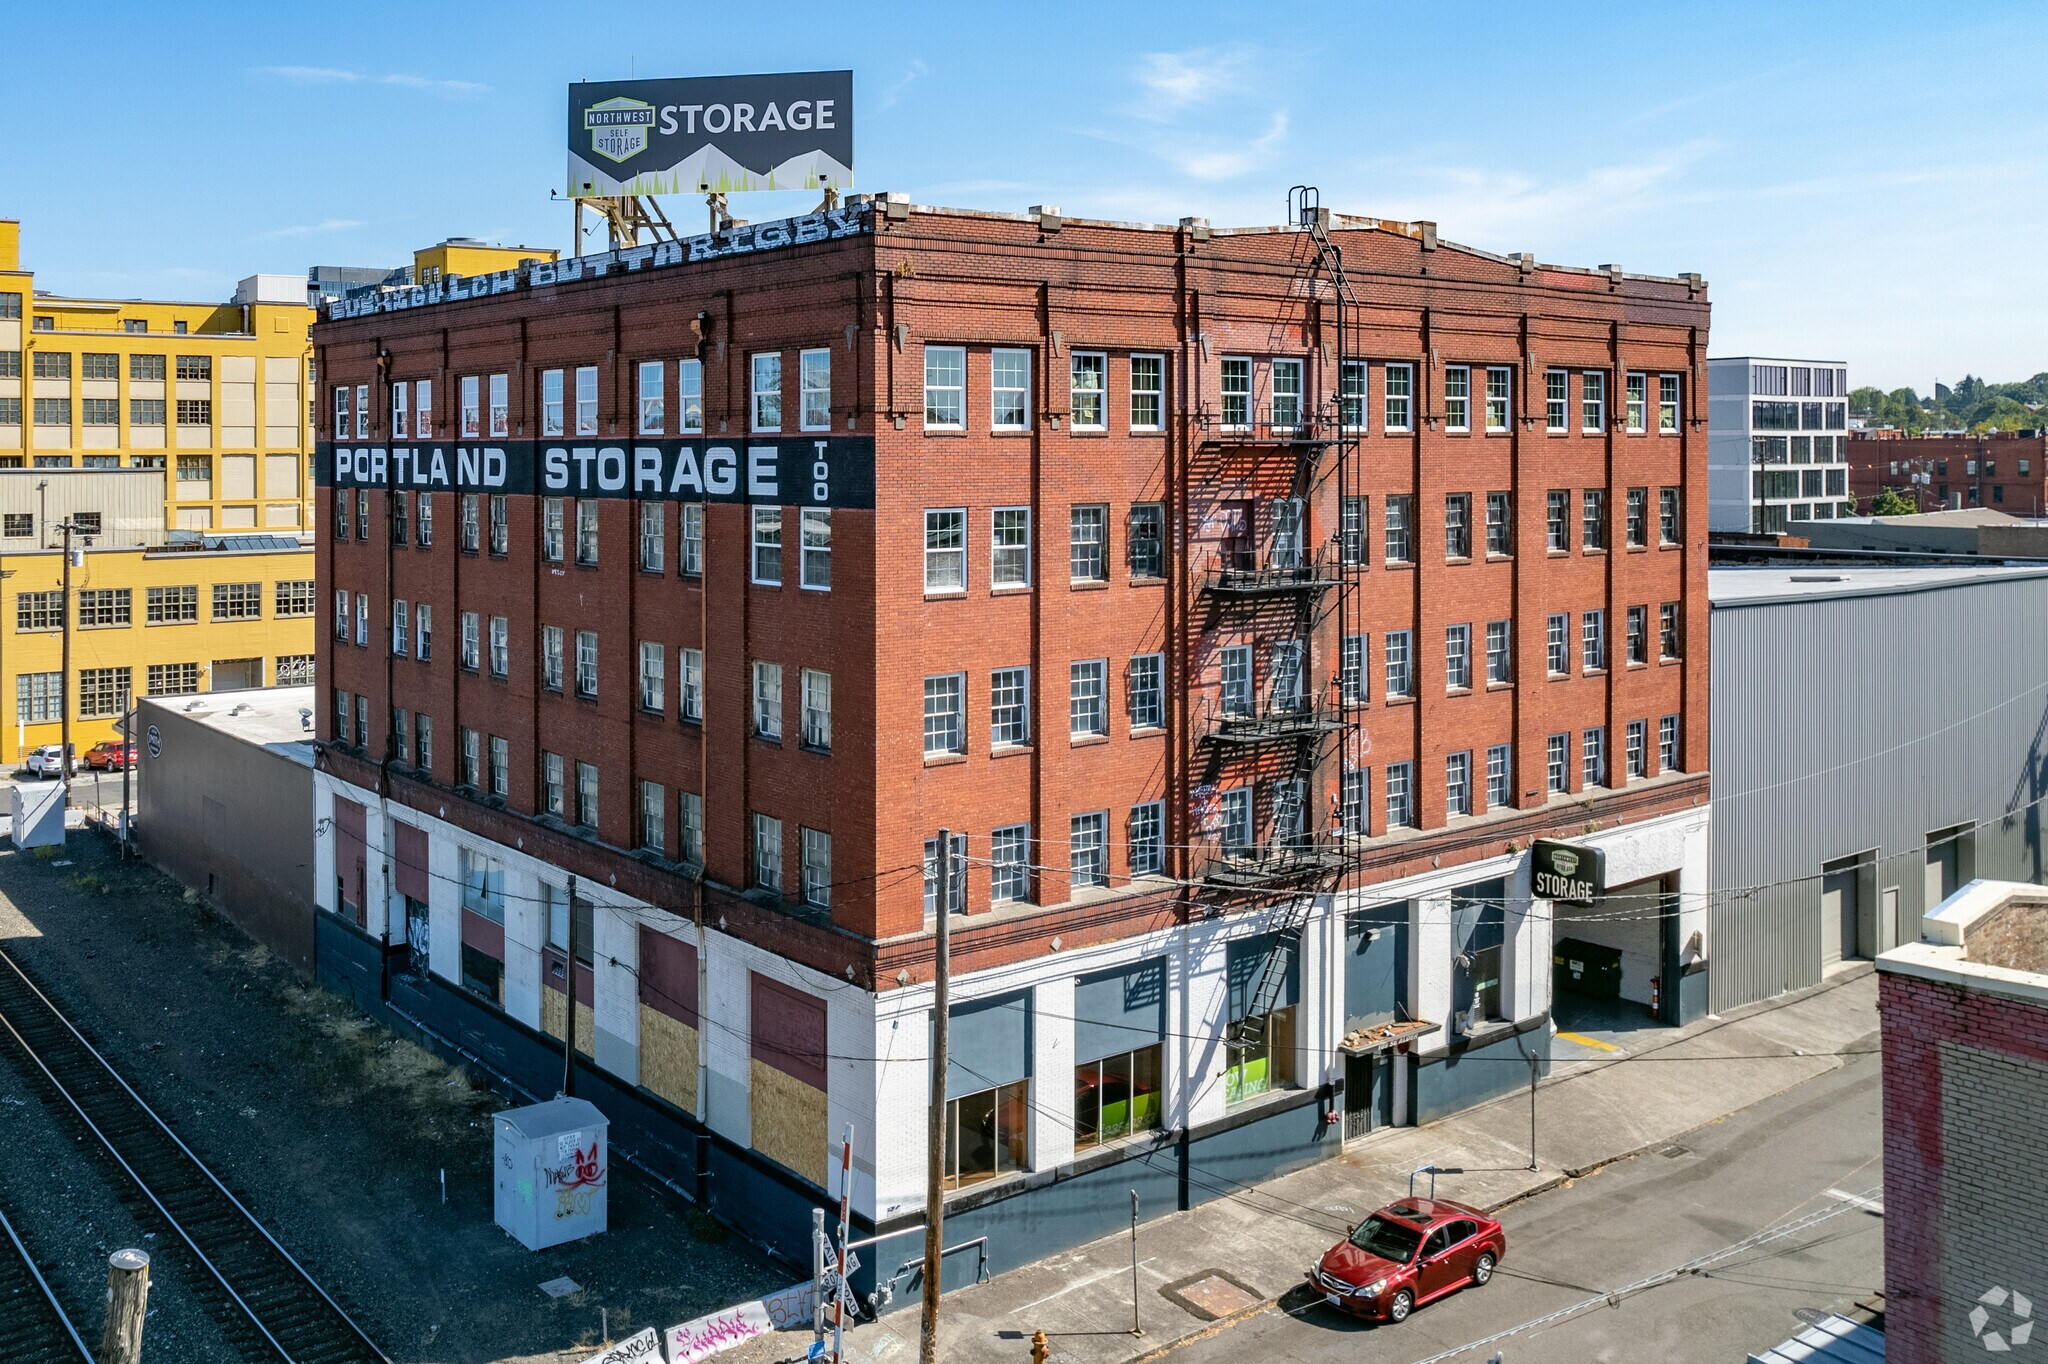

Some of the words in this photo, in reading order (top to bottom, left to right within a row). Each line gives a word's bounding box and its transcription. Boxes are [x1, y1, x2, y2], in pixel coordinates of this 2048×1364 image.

[589, 111, 651, 124] NORTHWEST
[610, 129, 628, 137] SELF
[659, 100, 836, 136] STORAGE
[598, 137, 640, 156] STORAGE
[336, 448, 507, 487] PORTLAND
[545, 446, 778, 496] STORAGE
[813, 441, 829, 501] TOO
[1537, 872, 1593, 903] STORAGE
